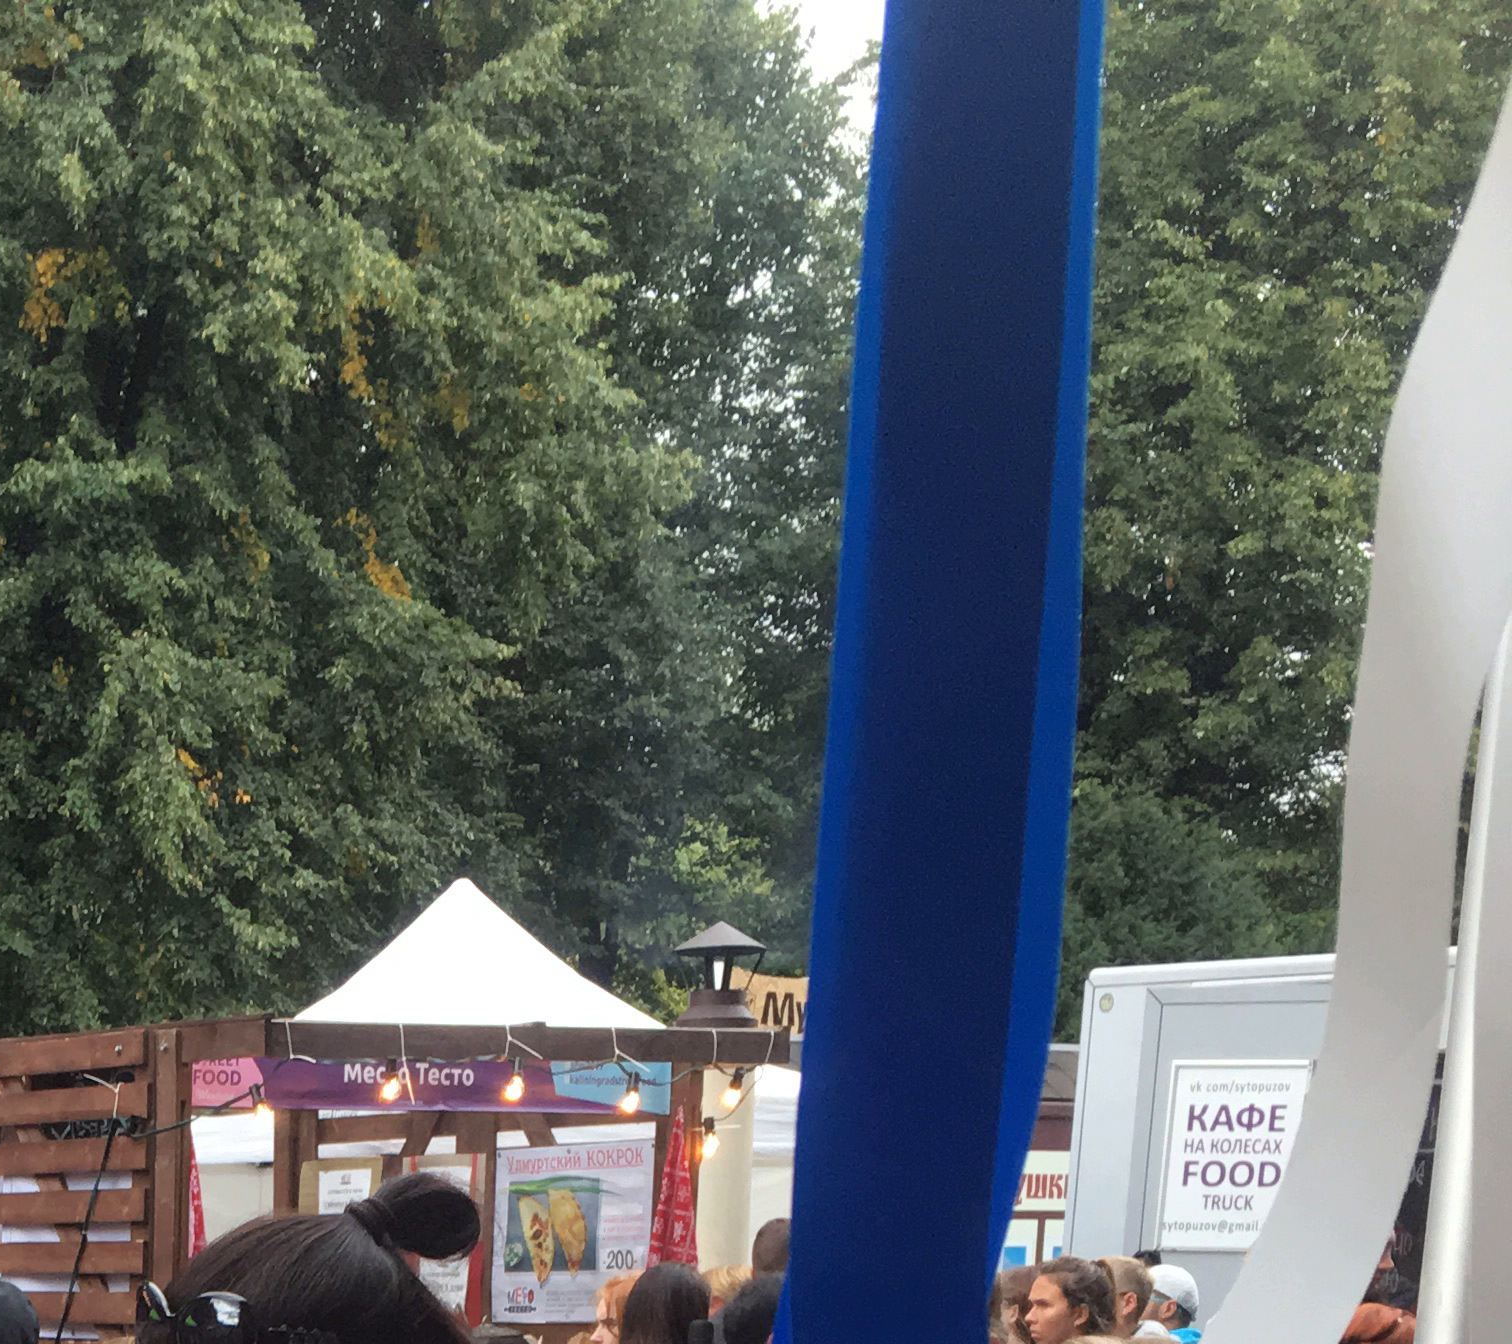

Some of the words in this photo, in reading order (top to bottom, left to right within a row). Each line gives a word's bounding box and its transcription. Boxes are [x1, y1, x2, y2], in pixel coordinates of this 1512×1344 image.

[193, 1070, 241, 1086] FOOD
[344, 1062, 408, 1084] Месо
[415, 1062, 475, 1086] Тесто
[1187, 1104, 1288, 1132] КАФЕ
[1183, 1138, 1205, 1154] НА
[1210, 1138, 1283, 1154] КОЛЕСАХ
[506, 1153, 582, 1174] Удмуртский
[587, 1147, 644, 1167] КОКРОК
[1182, 1160, 1282, 1188] FOOD
[1202, 1194, 1254, 1211] TRUCK
